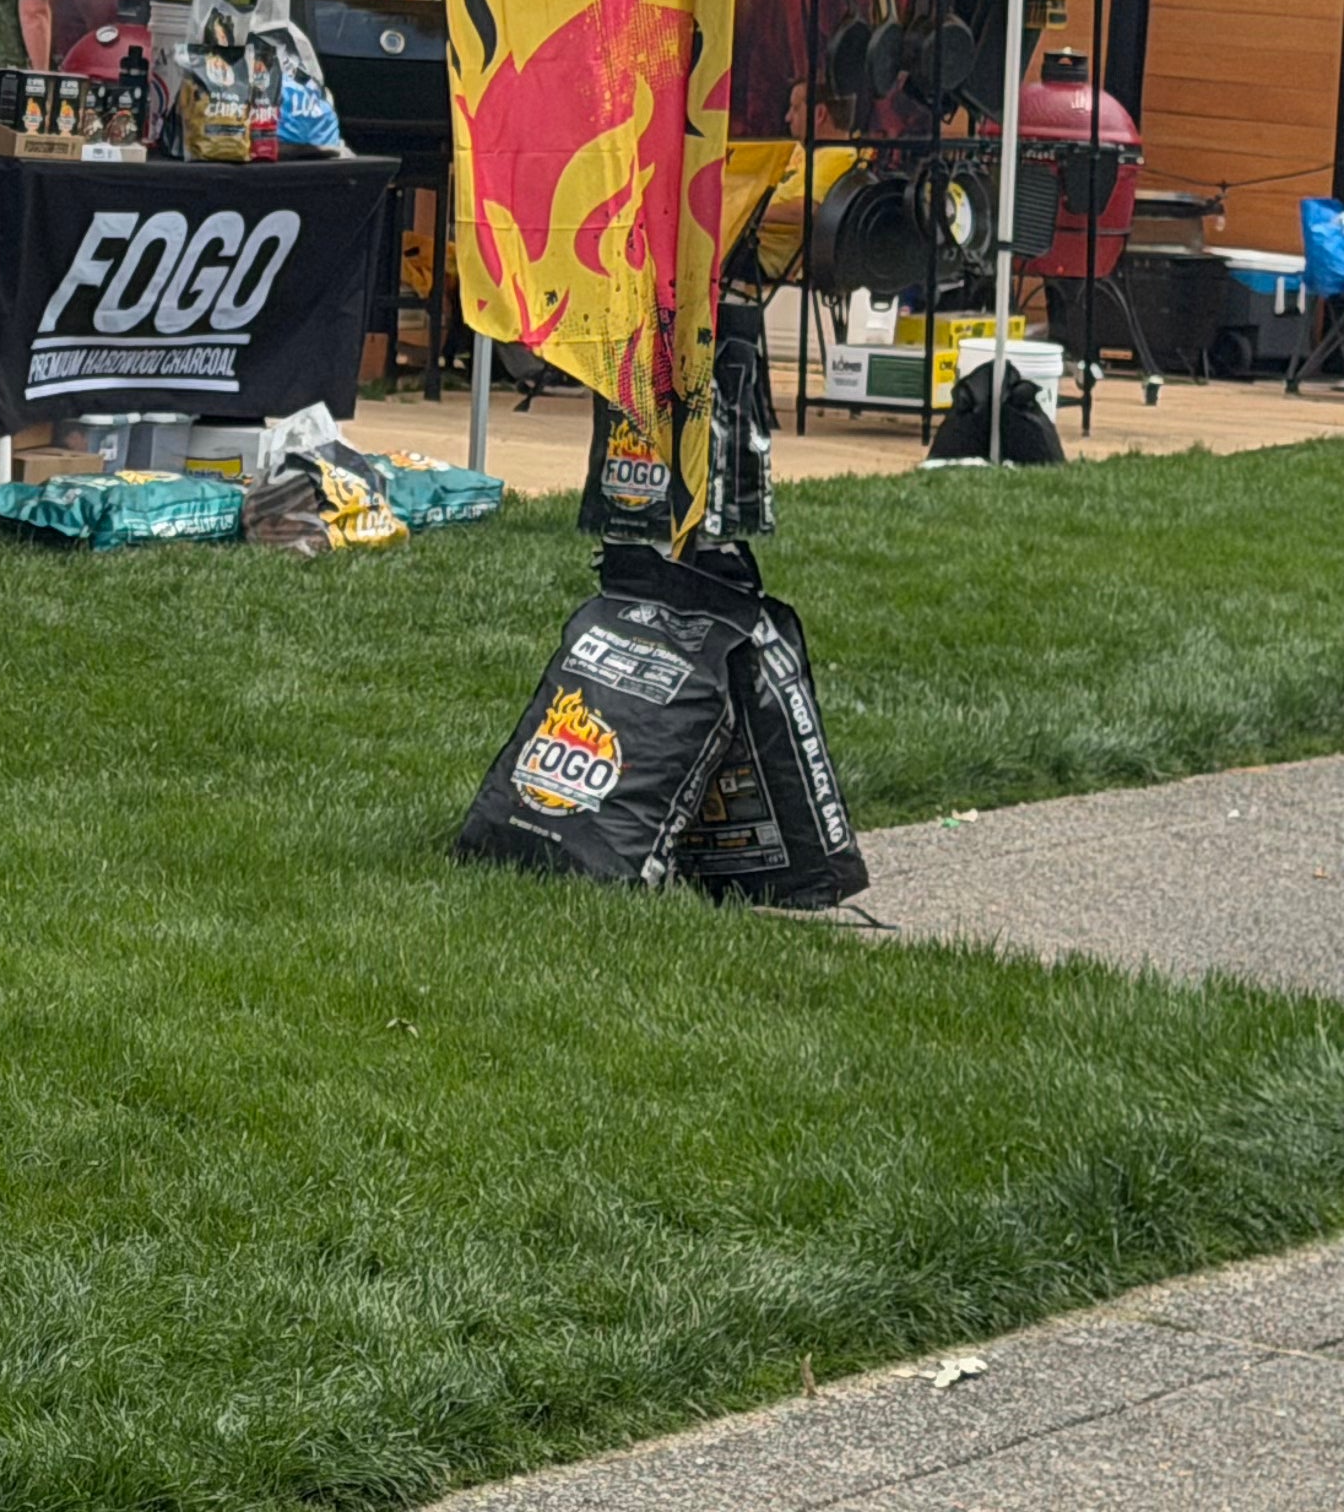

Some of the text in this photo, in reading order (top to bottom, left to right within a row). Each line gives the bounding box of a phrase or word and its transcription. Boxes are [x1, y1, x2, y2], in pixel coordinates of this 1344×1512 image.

[38, 209, 302, 334] FOGO
[28, 347, 237, 384] PREMIUM HARDWOOD CHARCOAL
[606, 458, 666, 486] FOGO
[522, 738, 614, 790] FOGO
[785, 682, 814, 737] FOGO
[801, 736, 831, 803] BLACK
